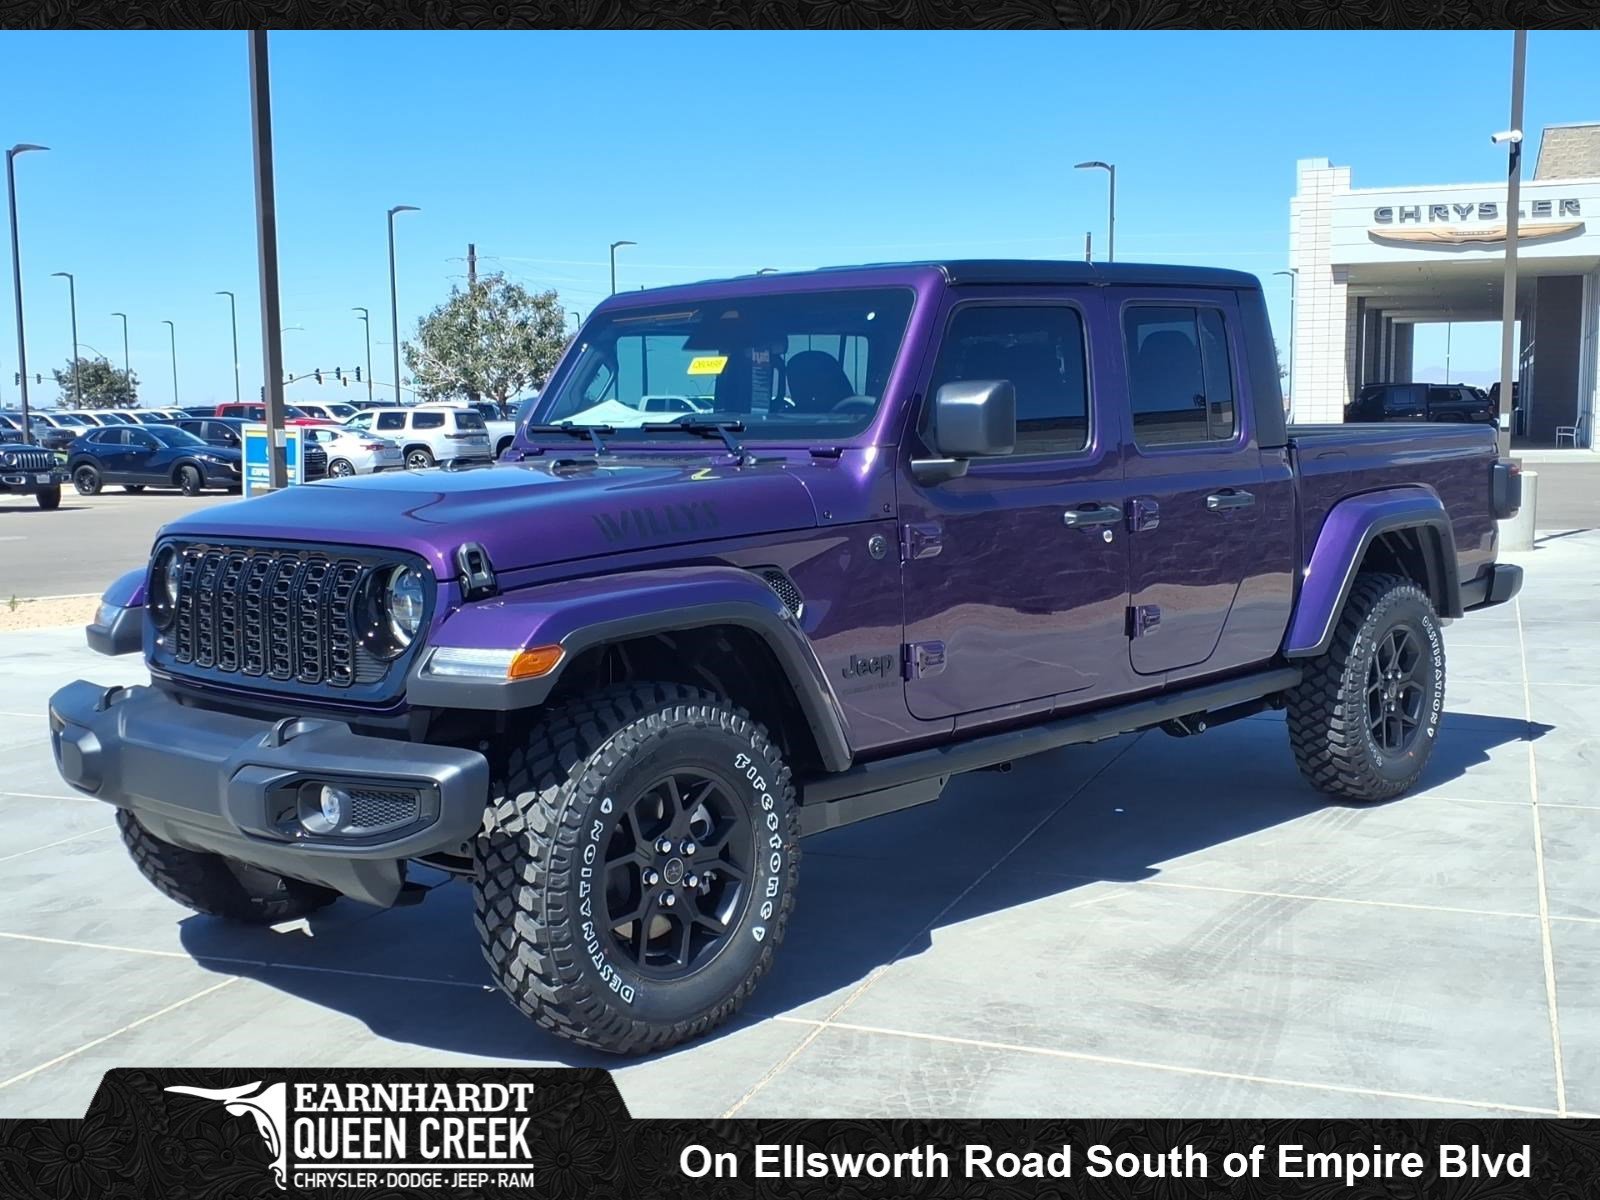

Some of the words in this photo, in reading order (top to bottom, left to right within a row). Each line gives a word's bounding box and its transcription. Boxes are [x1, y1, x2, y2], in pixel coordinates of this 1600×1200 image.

[1373, 197, 1582, 225] CHRYSER
[591, 499, 721, 543] WILLYS
[841, 654, 896, 680] Jeep
[579, 819, 636, 1004] DESTINATION
